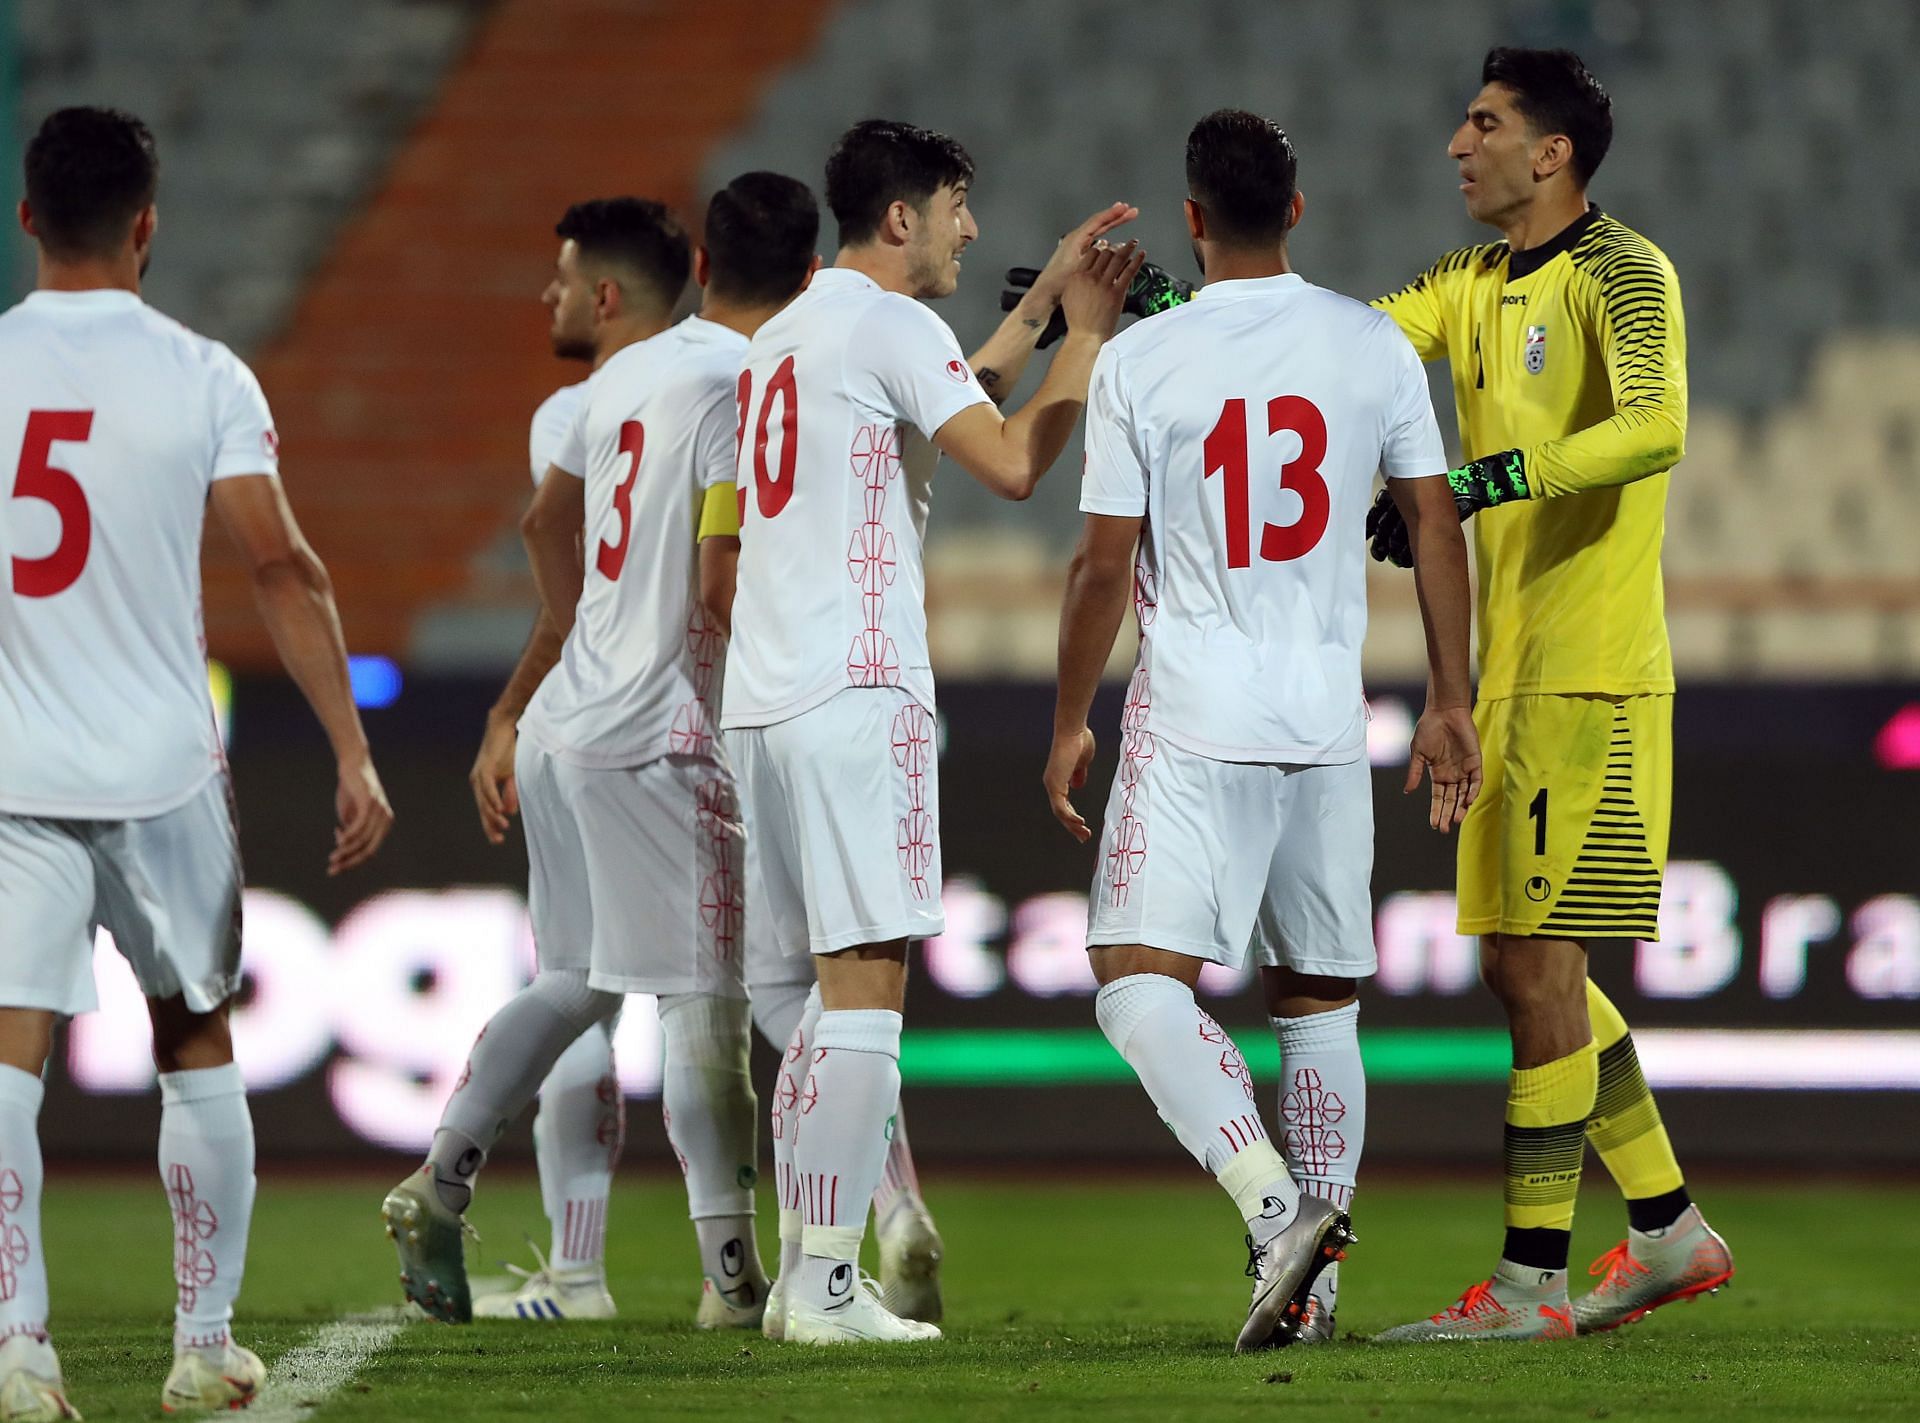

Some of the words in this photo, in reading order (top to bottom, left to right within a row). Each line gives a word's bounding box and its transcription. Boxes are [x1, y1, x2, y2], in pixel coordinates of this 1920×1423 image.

[12, 410, 94, 598] 5
[597, 421, 645, 581] 3
[1203, 395, 1330, 569] 13
[1528, 788, 1548, 856] 1
